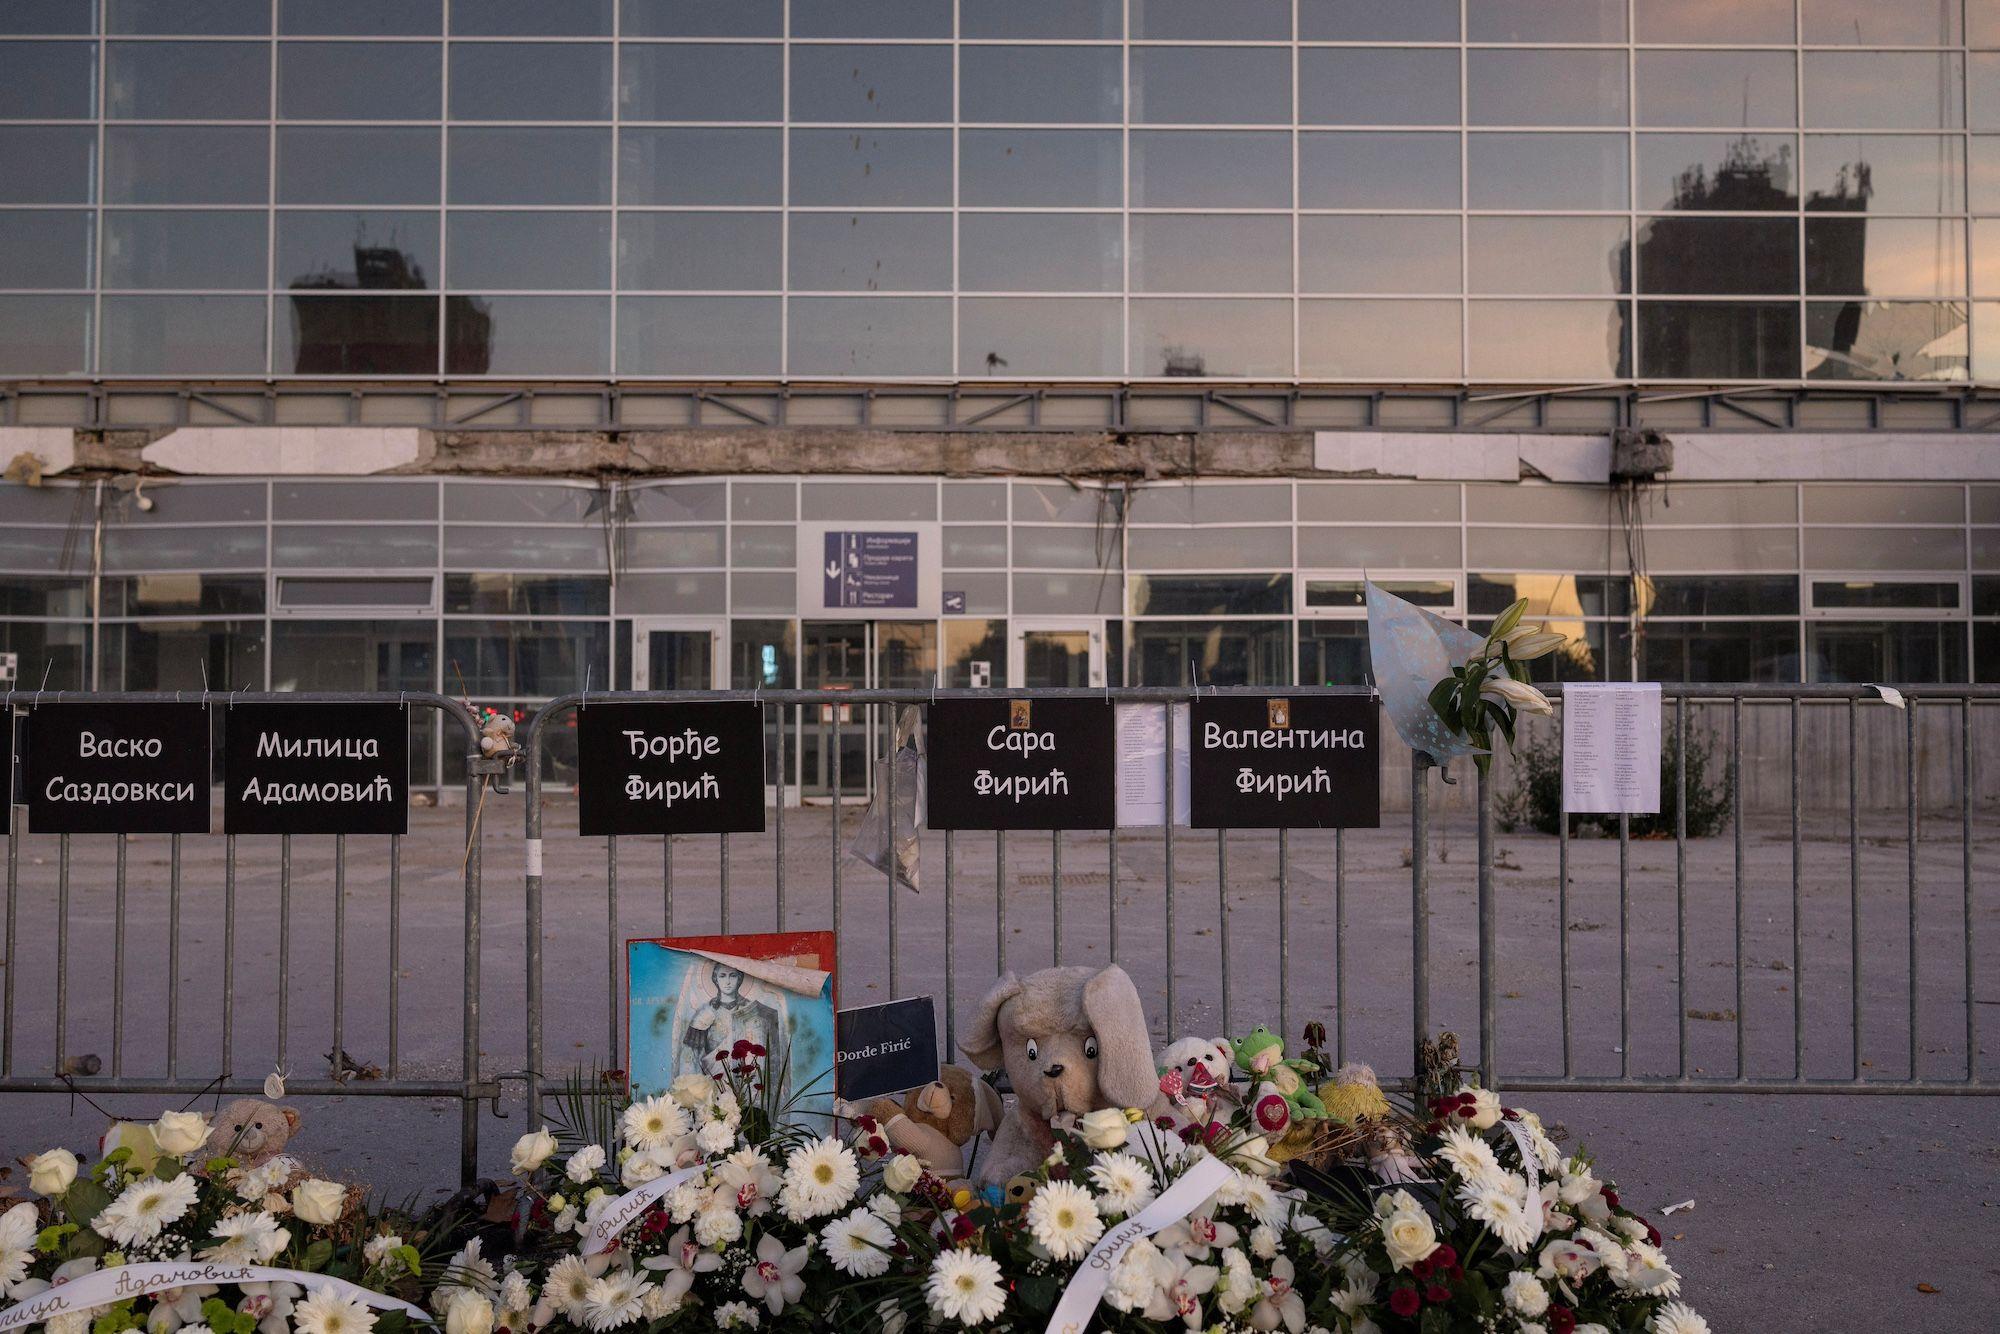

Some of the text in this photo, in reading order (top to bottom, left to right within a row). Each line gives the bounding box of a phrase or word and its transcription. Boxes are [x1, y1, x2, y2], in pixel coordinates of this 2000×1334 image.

[80, 731, 163, 758] Васко
[256, 731, 379, 761] Милица
[621, 727, 721, 764] Ђорђе
[986, 724, 1056, 759] Сара
[1204, 721, 1366, 750] Валентина
[45, 775, 194, 805] Саздовкси
[241, 774, 393, 805] Адамовић
[624, 771, 720, 808] Фирић
[973, 768, 1069, 804] Фирић
[1235, 765, 1332, 802] Фирић
[880, 1037, 912, 1054] Firić
